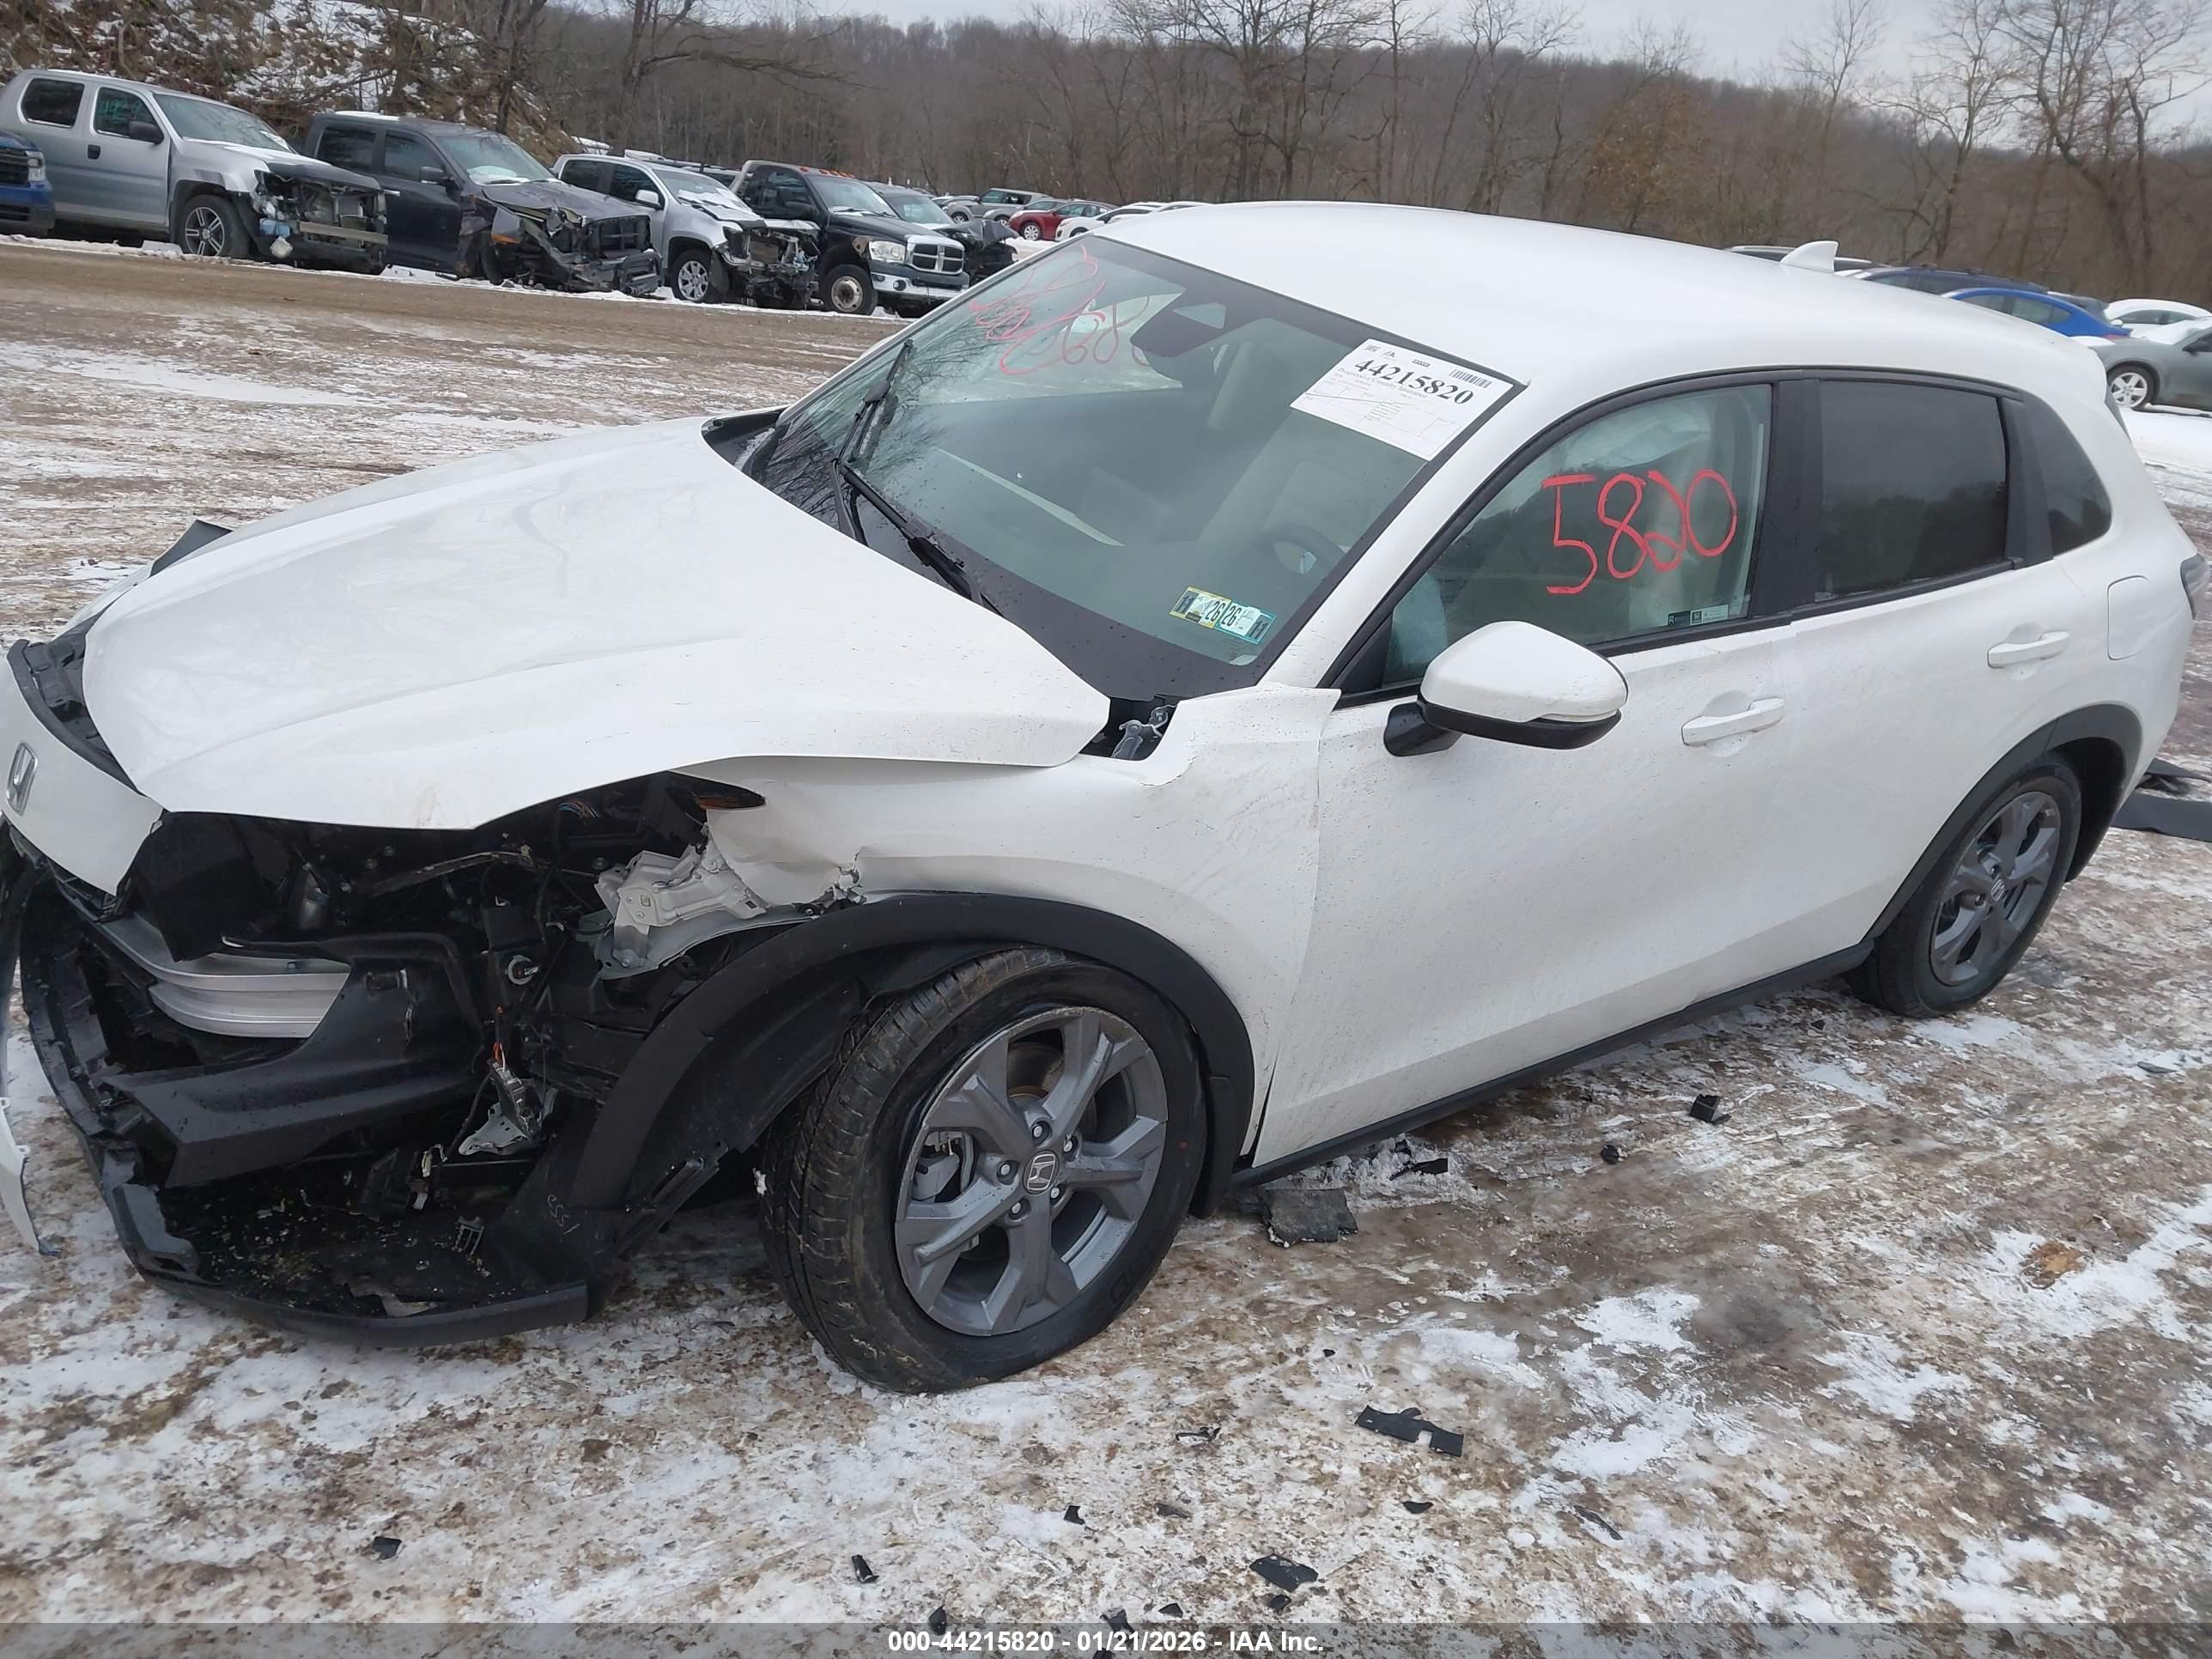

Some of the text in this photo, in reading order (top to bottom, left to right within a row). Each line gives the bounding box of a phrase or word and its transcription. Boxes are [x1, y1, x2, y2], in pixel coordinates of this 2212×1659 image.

[1354, 359, 1474, 404] 44215820
[1541, 469, 1738, 593] 5820
[1204, 600, 1226, 622] 26
[1221, 605, 1243, 627] 26
